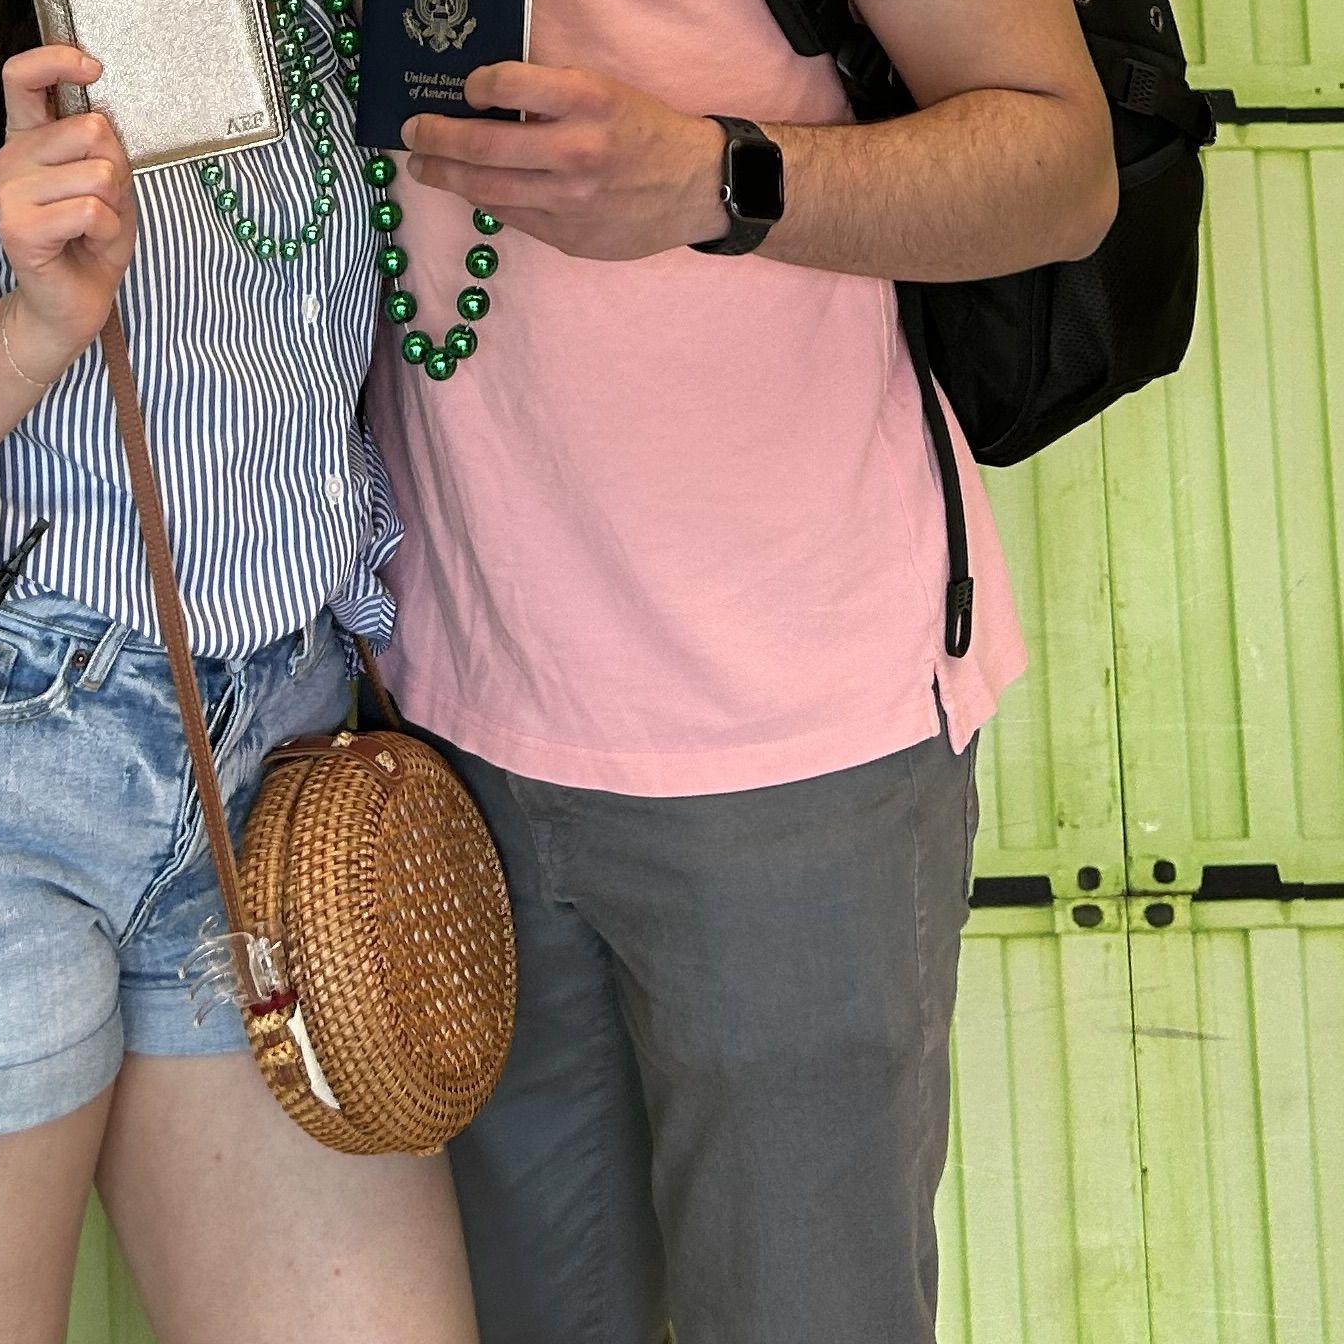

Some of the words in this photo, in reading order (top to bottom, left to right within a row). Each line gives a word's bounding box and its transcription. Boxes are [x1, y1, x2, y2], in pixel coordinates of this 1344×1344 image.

[404, 71, 438, 85] United
[439, 73, 465, 87] State
[408, 85, 422, 100] of
[421, 86, 463, 101] America
